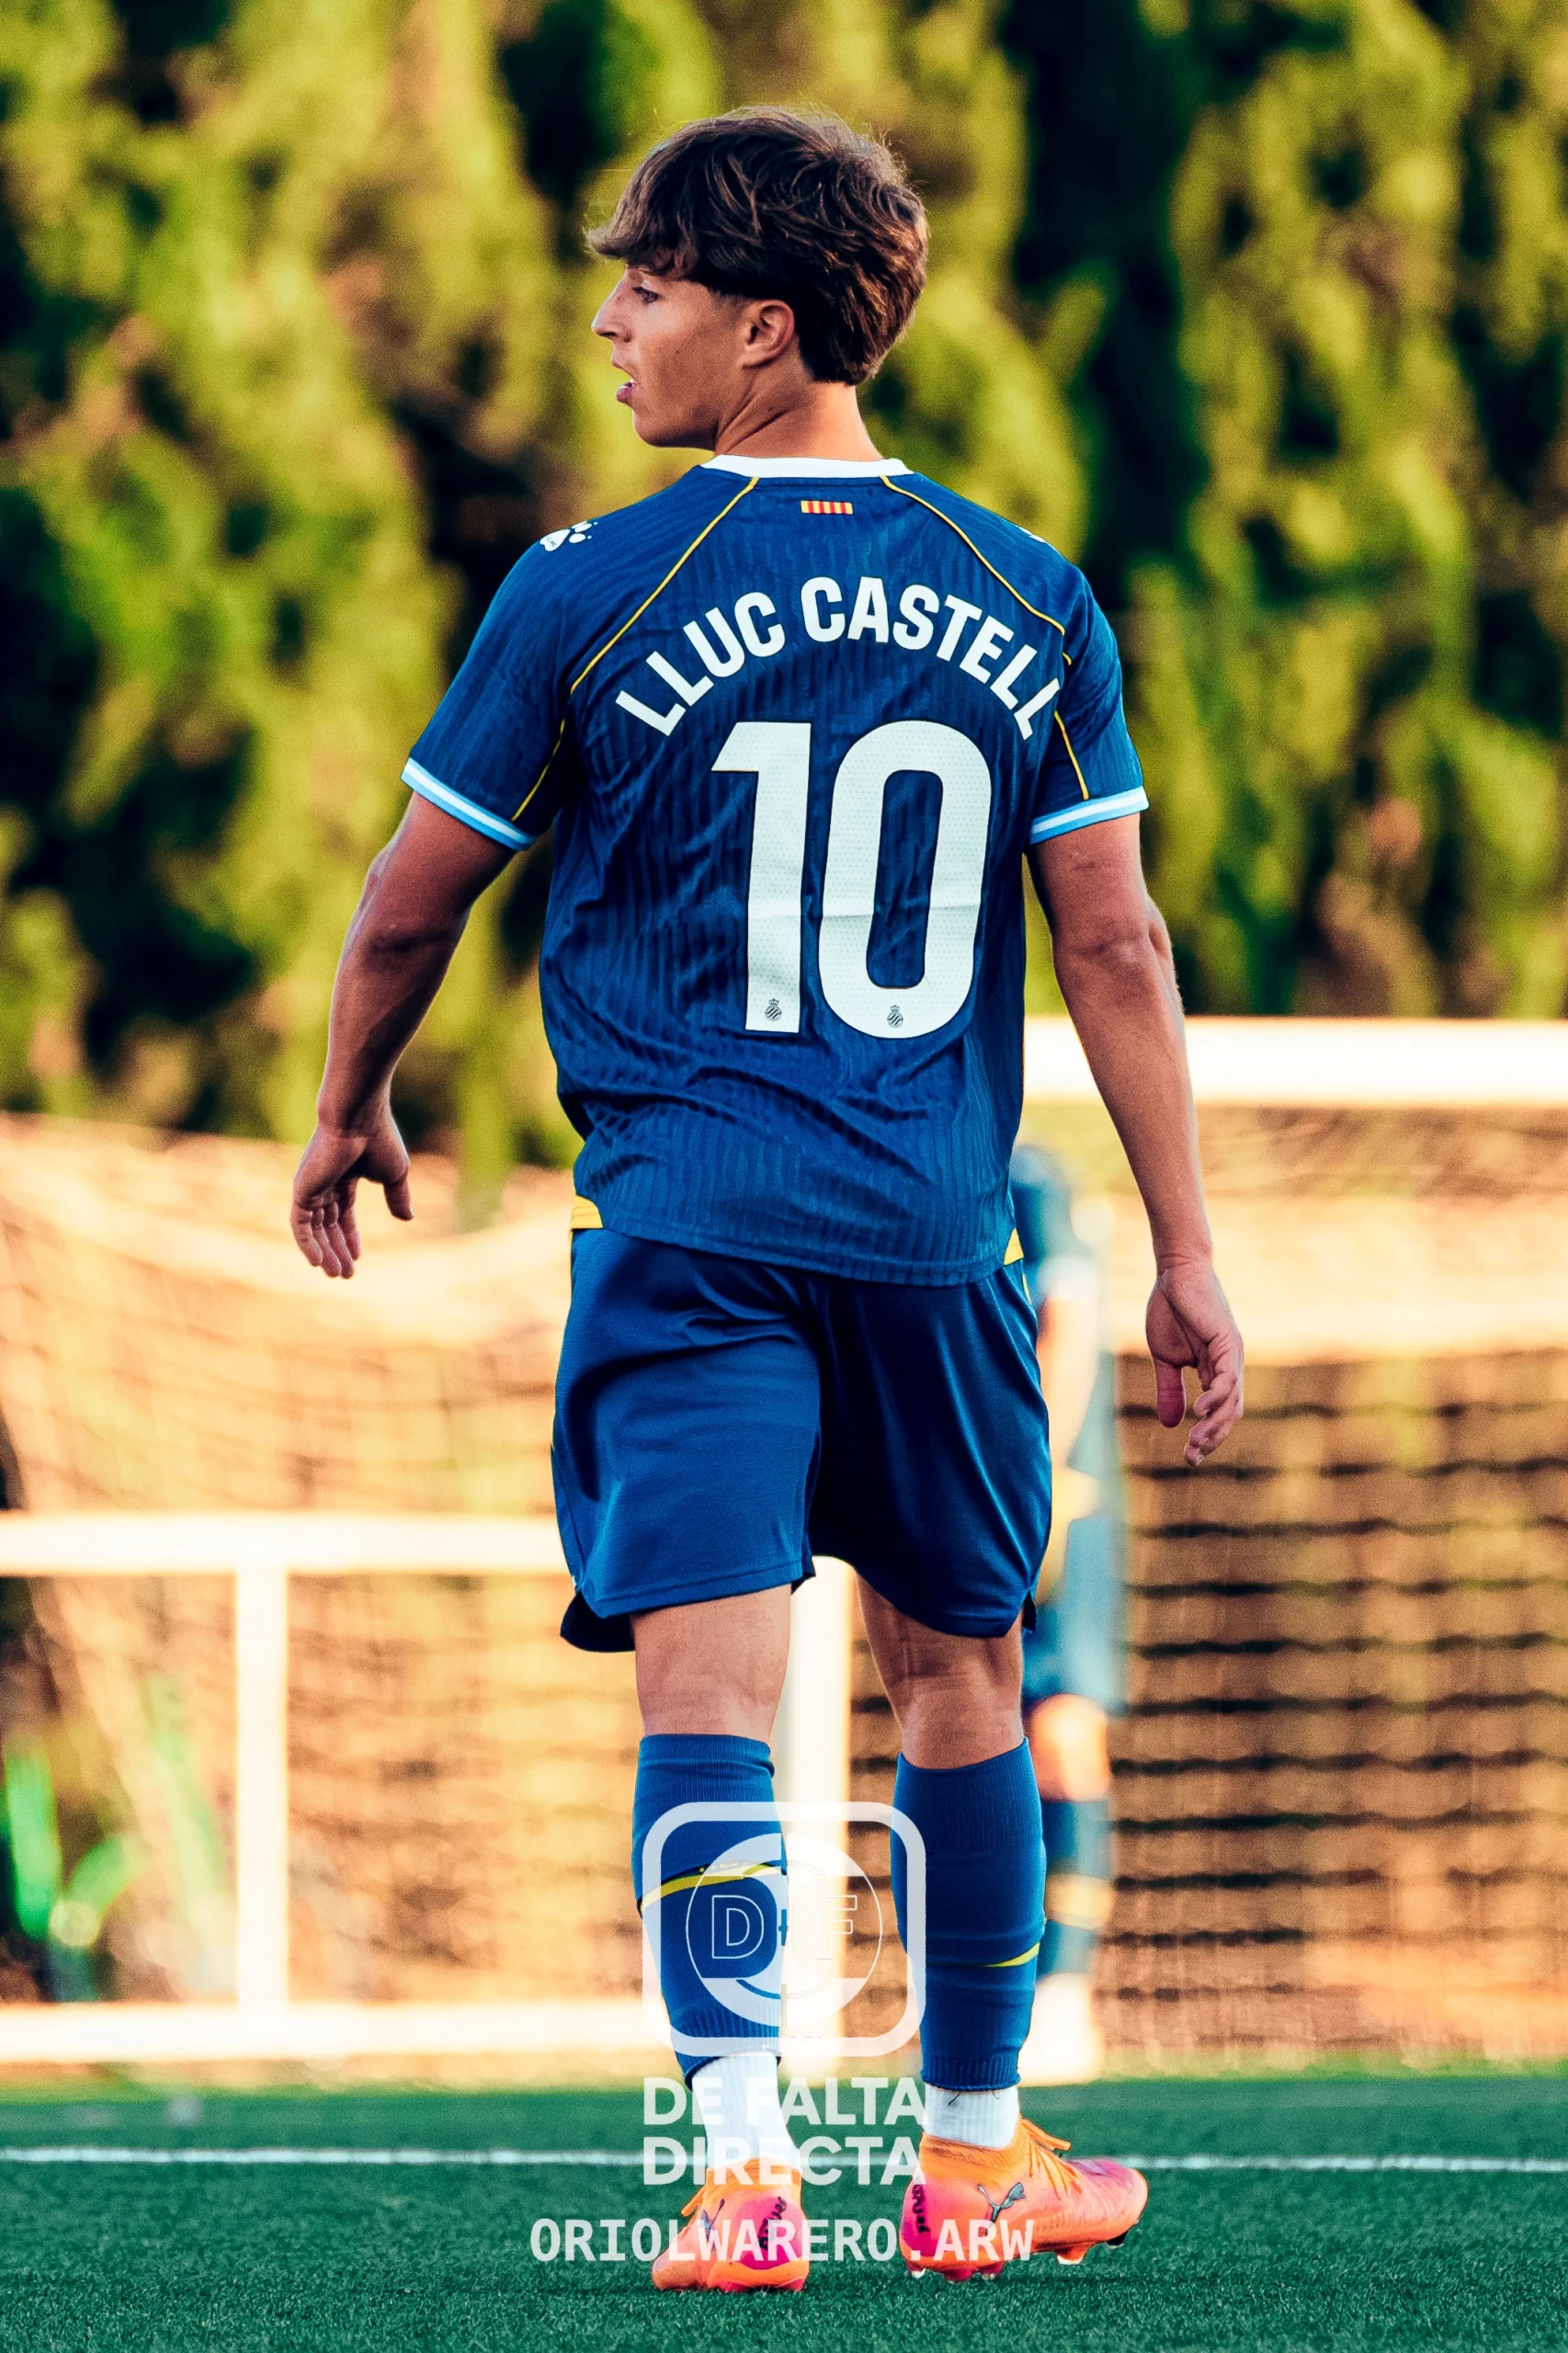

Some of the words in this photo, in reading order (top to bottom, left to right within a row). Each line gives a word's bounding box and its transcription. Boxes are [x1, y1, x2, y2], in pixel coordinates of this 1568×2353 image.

[616, 592, 786, 736] LLUC
[801, 576, 1061, 740] CASTELL
[710, 720, 992, 1039] 10
